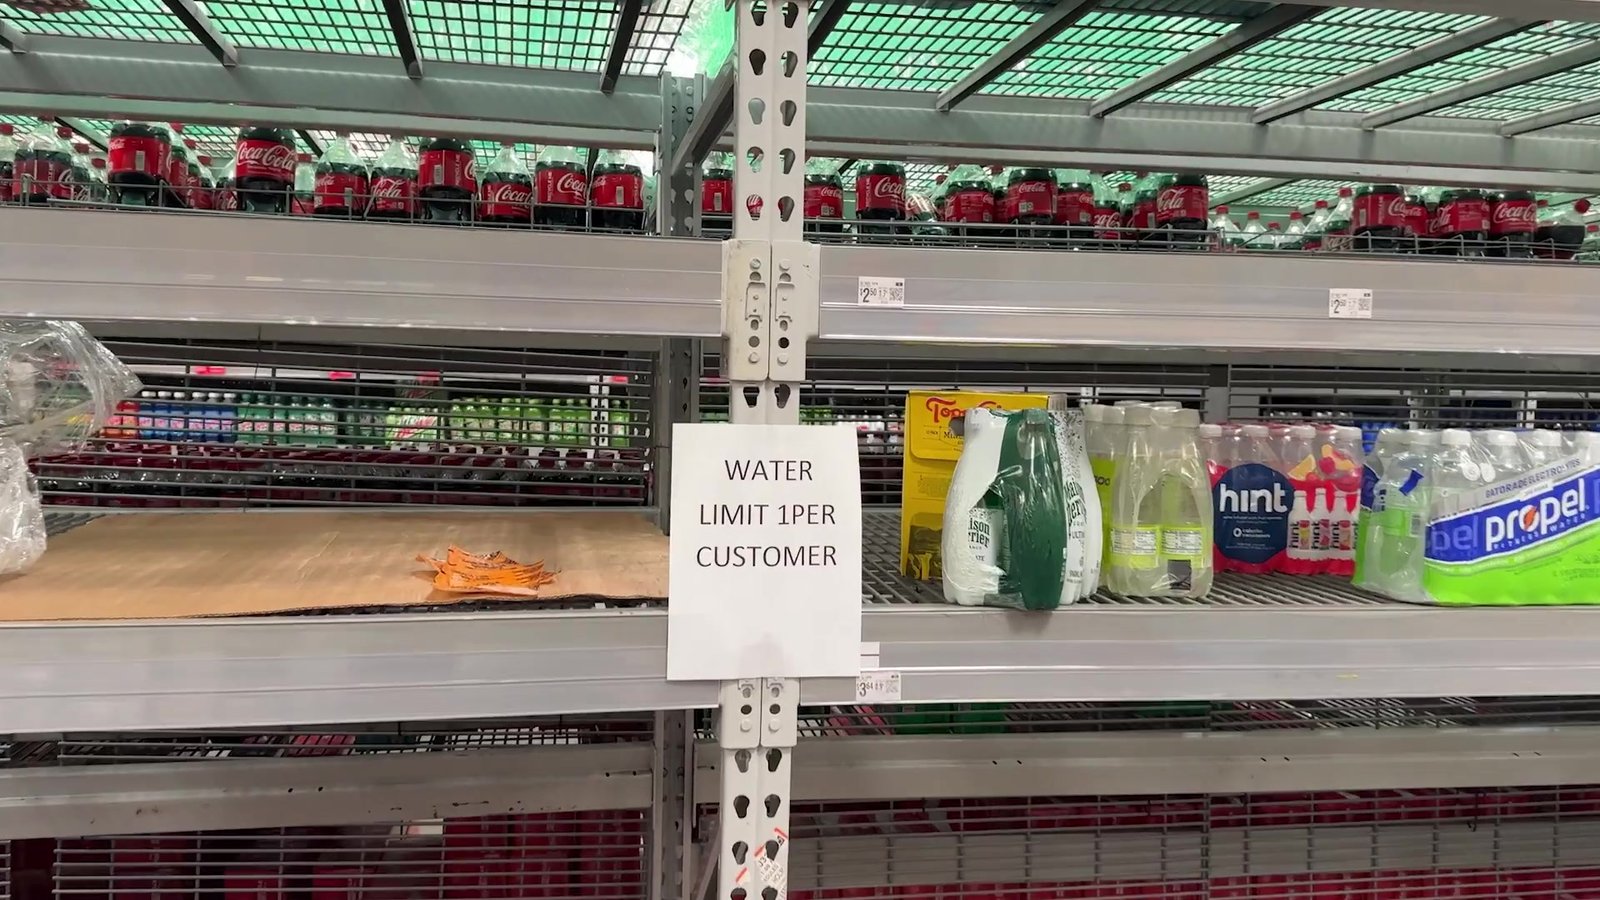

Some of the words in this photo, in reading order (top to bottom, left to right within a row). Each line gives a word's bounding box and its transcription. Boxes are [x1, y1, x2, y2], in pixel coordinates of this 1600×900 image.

[237, 142, 299, 171] Coca-Cola
[725, 459, 813, 481] WATER
[1219, 483, 1288, 513] hint
[700, 504, 769, 525] LIMIT
[778, 504, 836, 525] 1PER
[1485, 478, 1585, 552] propel
[1549, 513, 1585, 532] WATER
[968, 517, 990, 536] ison
[1288, 521, 1300, 549] hint
[696, 545, 837, 567] CUSTOMER
